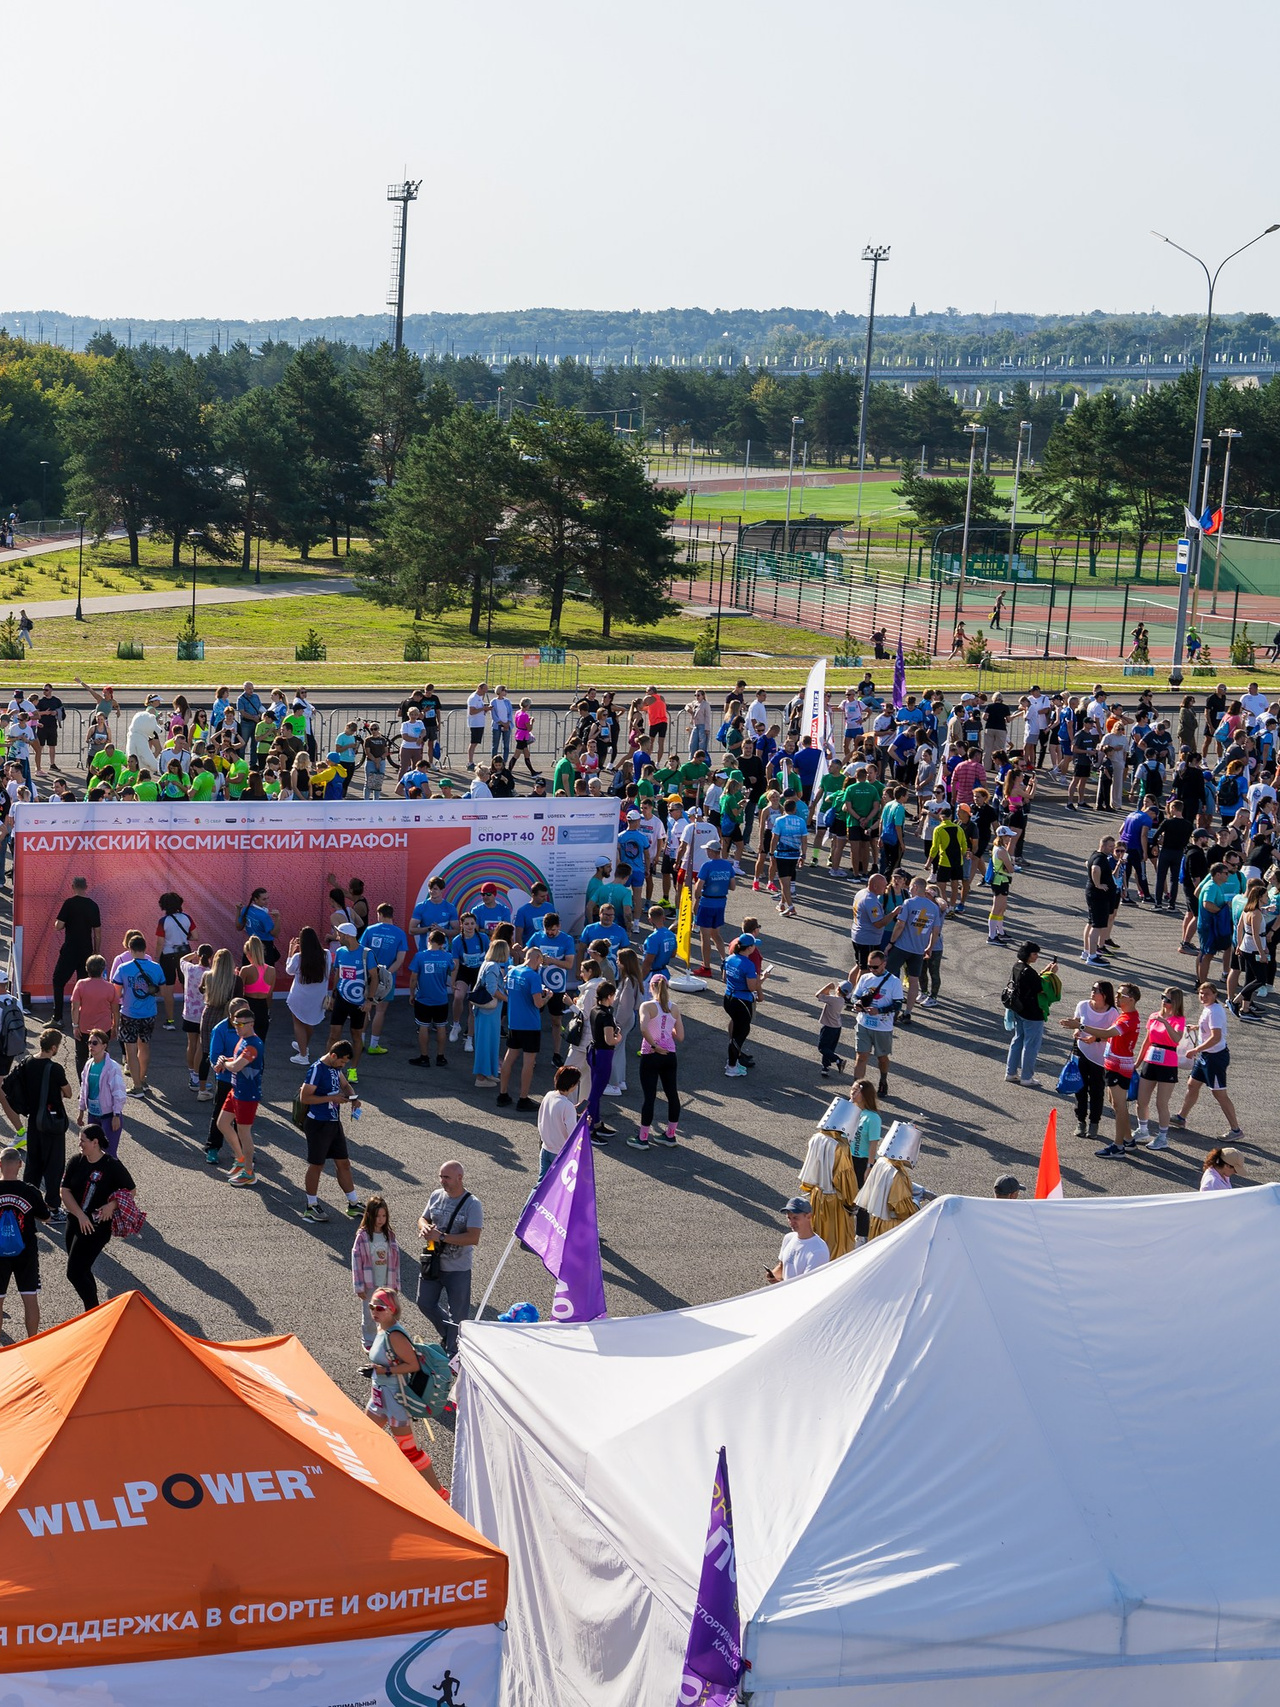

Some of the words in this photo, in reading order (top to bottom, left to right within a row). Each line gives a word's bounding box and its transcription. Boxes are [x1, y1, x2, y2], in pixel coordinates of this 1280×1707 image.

[23, 831, 150, 852] КАЛУЖСКИЙ
[155, 831, 304, 850] КОСМИЧЕСКИЙ
[309, 832, 408, 849] МАРАФОН
[478, 833, 517, 842] СПОРТ
[520, 832, 535, 841] 40
[541, 826, 555, 842] 29
[16, 1610, 199, 1645] ПОДДЕРЖКА
[206, 1608, 222, 1627] В
[229, 1597, 334, 1625] СПОРТЕ
[341, 1595, 359, 1614] И
[366, 1579, 488, 1612] ФИТНЕСЕ
